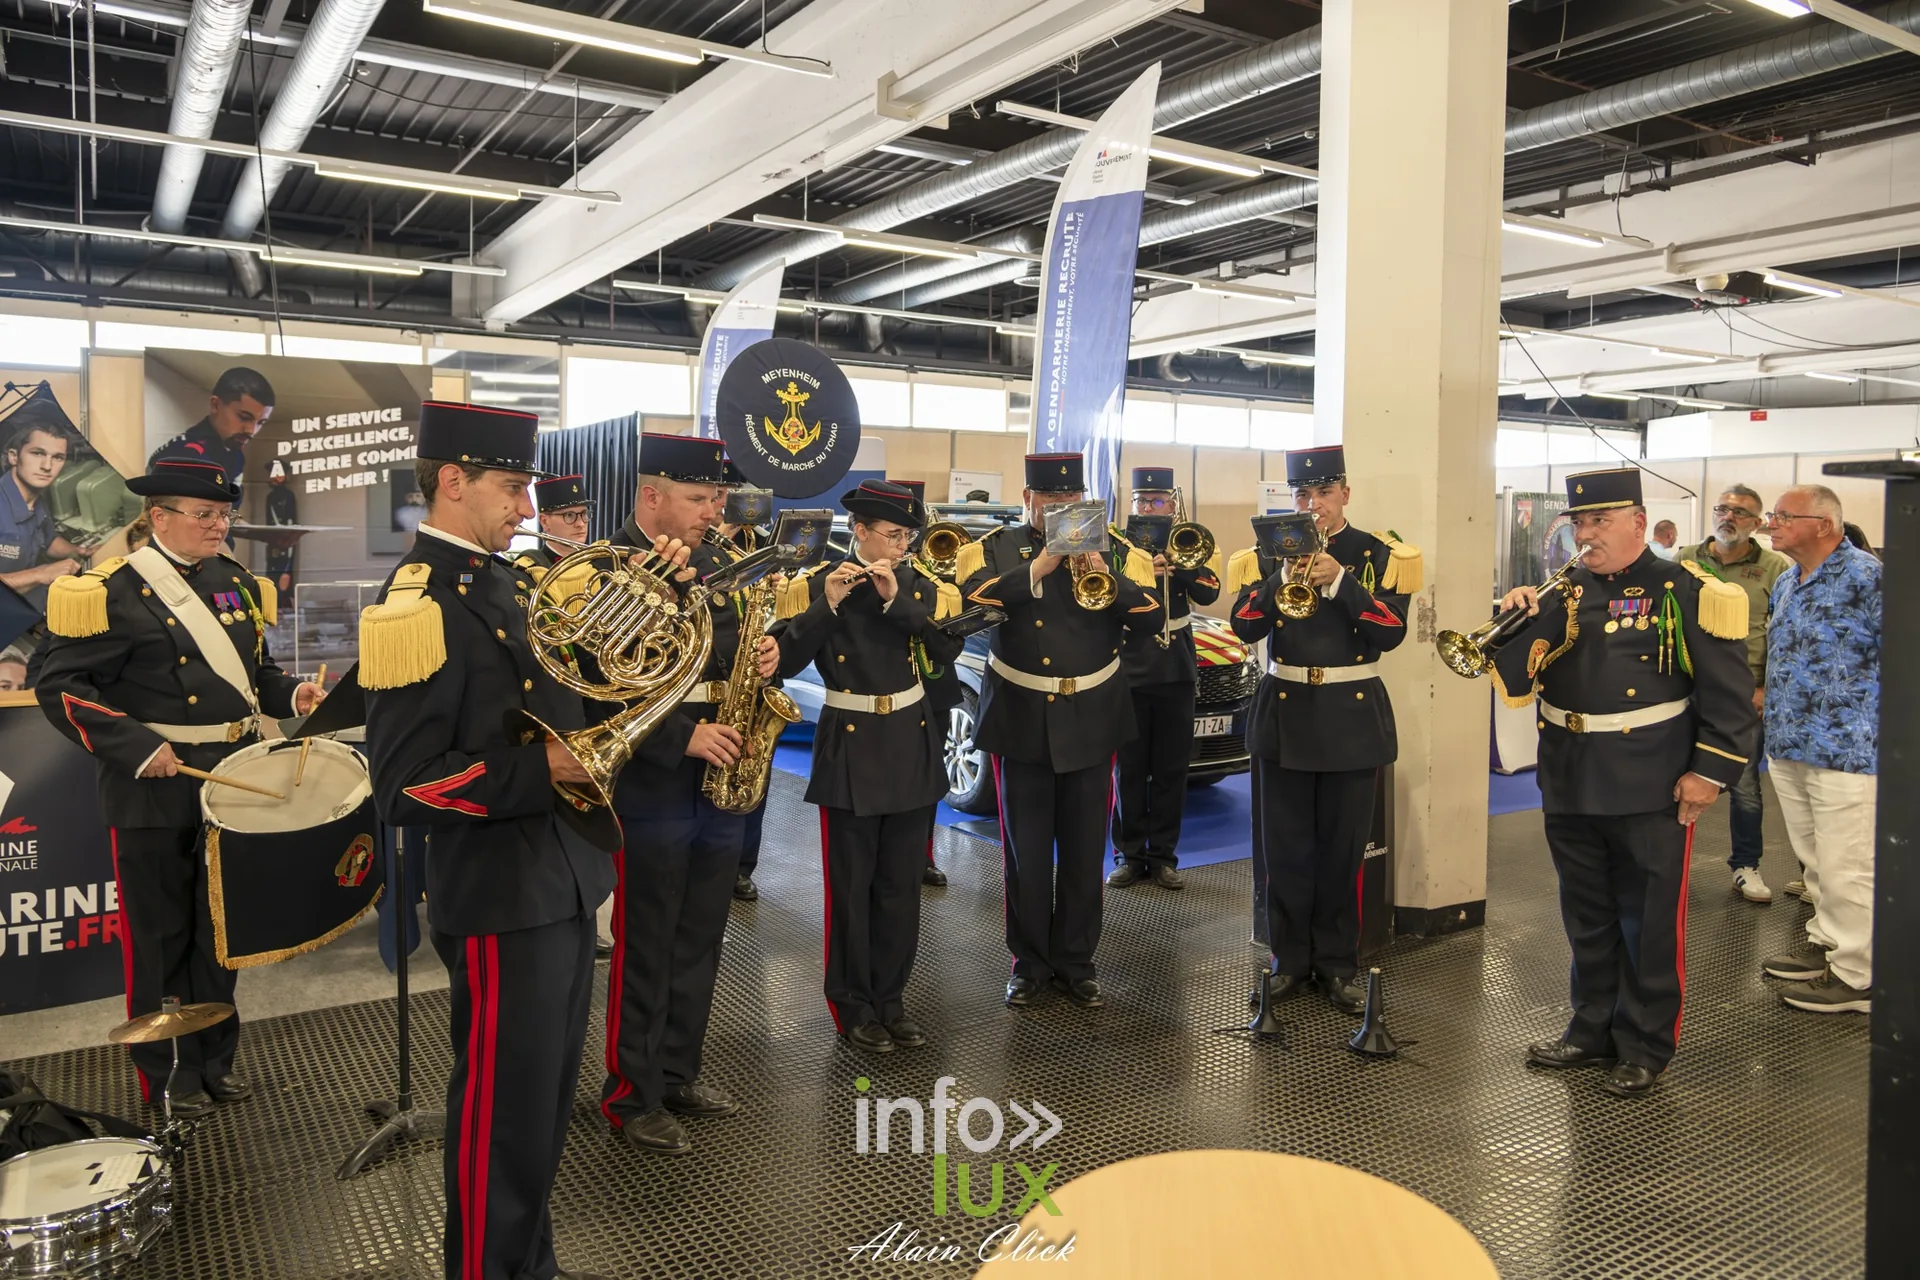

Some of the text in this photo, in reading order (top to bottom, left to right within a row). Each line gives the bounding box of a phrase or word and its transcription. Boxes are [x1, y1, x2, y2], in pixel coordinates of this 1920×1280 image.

[1047, 299, 1067, 432] GENDARMERIE
[1058, 212, 1075, 293] RECRUTE
[713, 334, 724, 385] RECRUTE
[1061, 355, 1069, 385] NOTRE
[761, 368, 820, 390] MEYENHEIM
[292, 407, 401, 433] UN SERVICE
[745, 414, 838, 472] RÉGIMENT DE MARCHE DU TCHAD
[270, 459, 286, 477] À
[290, 454, 352, 475] TERRE
[305, 469, 389, 494] EN MER !
